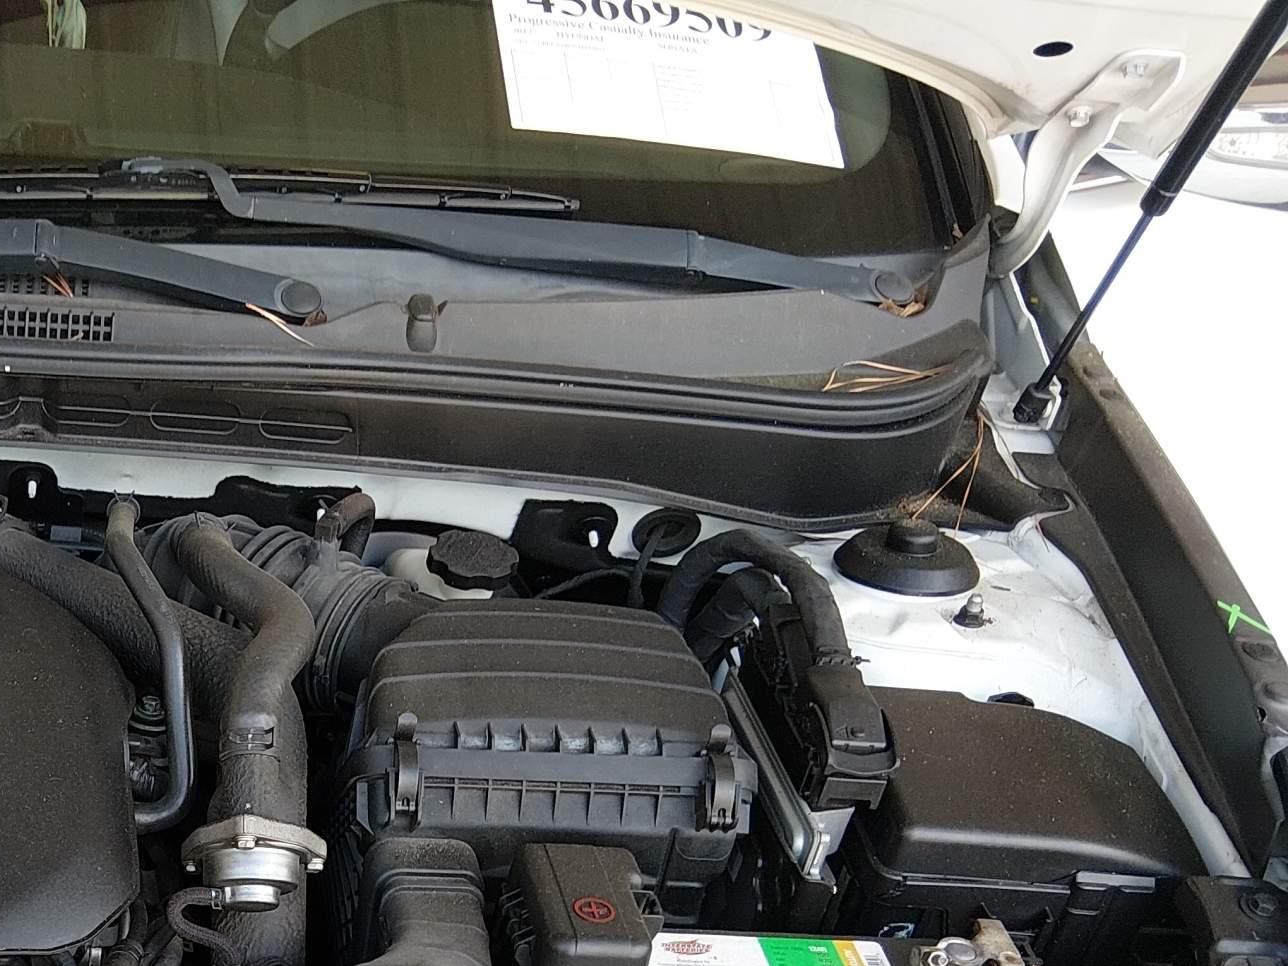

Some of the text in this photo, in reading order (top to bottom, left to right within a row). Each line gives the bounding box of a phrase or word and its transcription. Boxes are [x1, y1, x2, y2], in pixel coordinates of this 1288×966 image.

[509, 13, 710, 44] Progressive Casualty Insurance
